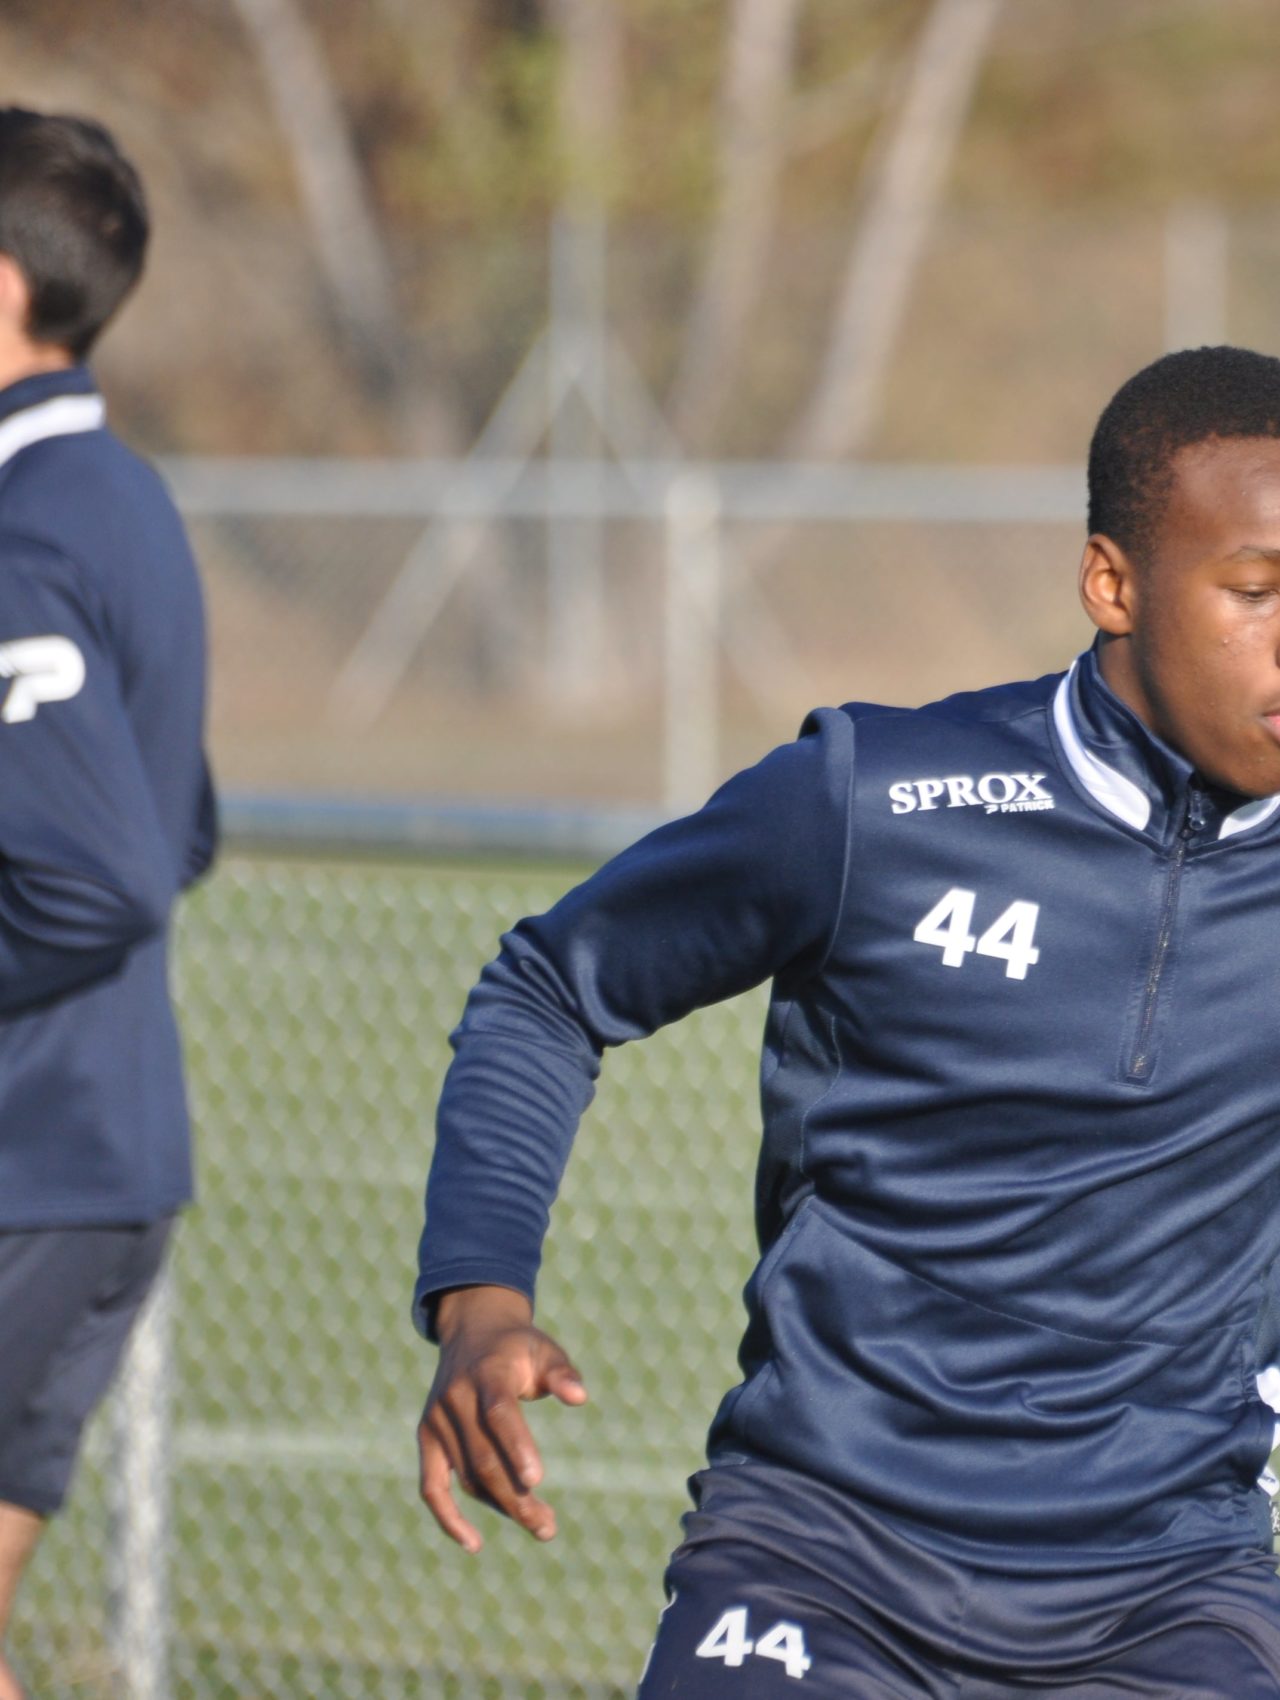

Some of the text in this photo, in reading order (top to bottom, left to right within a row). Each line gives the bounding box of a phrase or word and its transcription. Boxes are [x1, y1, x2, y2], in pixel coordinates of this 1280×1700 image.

[889, 772, 1052, 815] SPROX
[1000, 799, 1055, 813] PATRICK
[913, 887, 1040, 980] 44
[695, 1606, 811, 1679] 44
